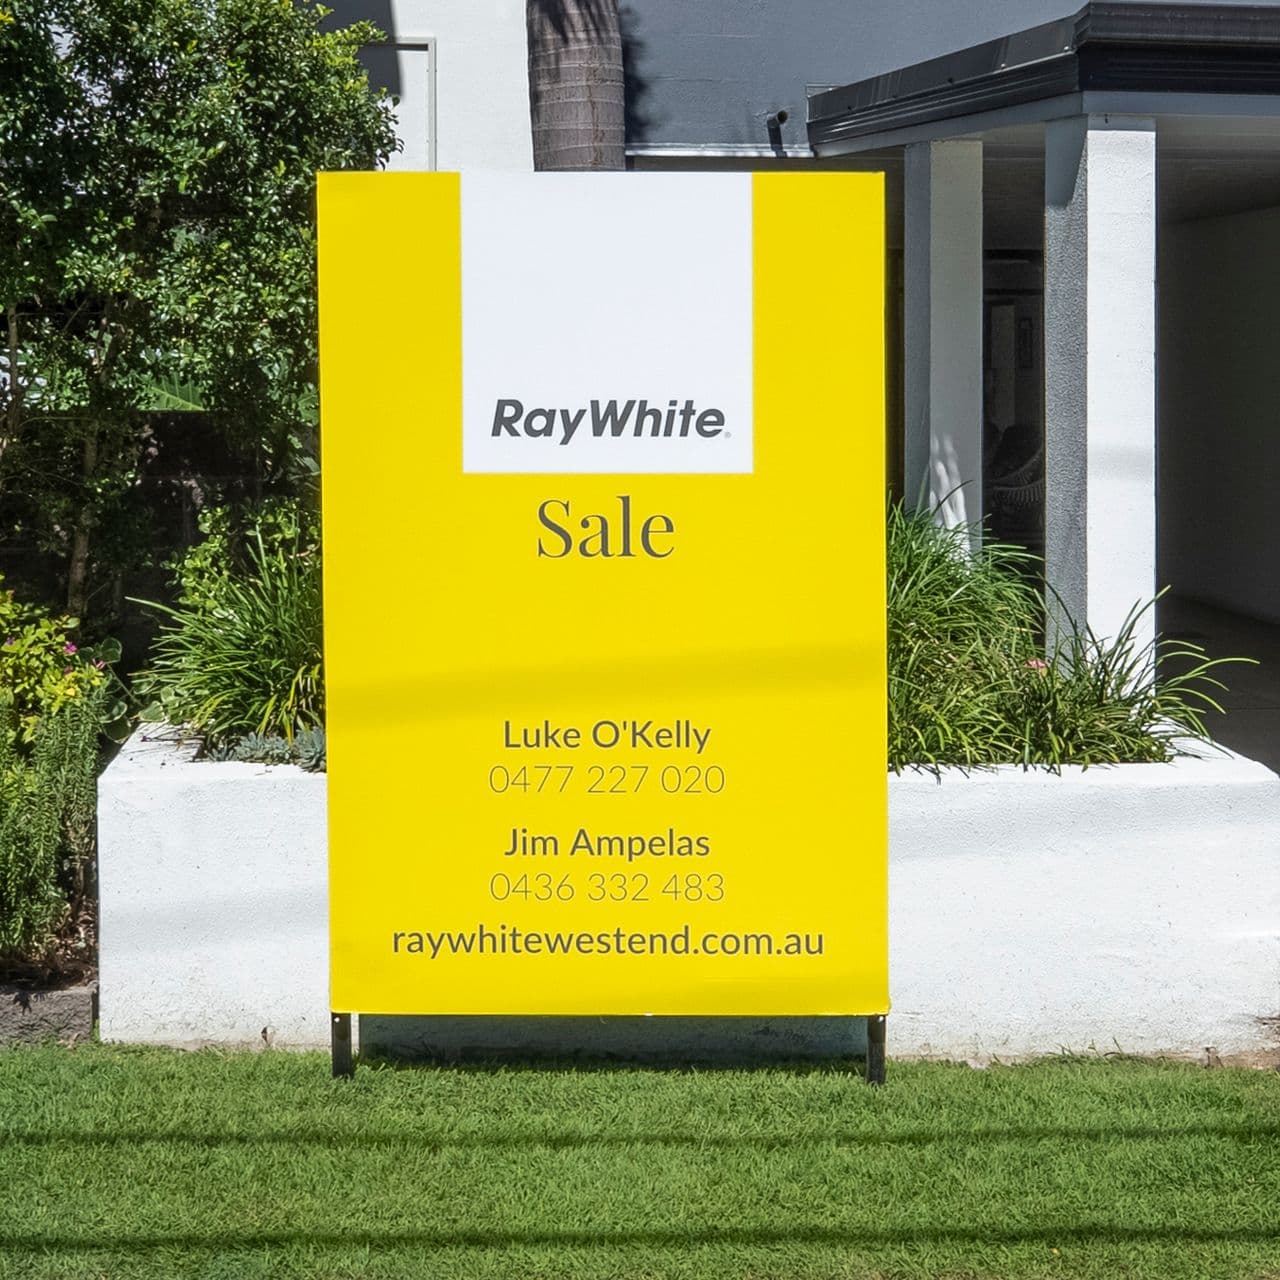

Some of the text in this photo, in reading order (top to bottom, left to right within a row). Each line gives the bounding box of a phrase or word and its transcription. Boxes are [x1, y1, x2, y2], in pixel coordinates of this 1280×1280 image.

[537, 495, 675, 558] Sale
[505, 719, 711, 754] Luke O'Kelly
[490, 766, 725, 793] 0477 227 020
[504, 827, 710, 862] Jim Ampelas
[490, 873, 725, 901] 0436 332 483
[394, 923, 823, 959] raywhitewestend.com.au
